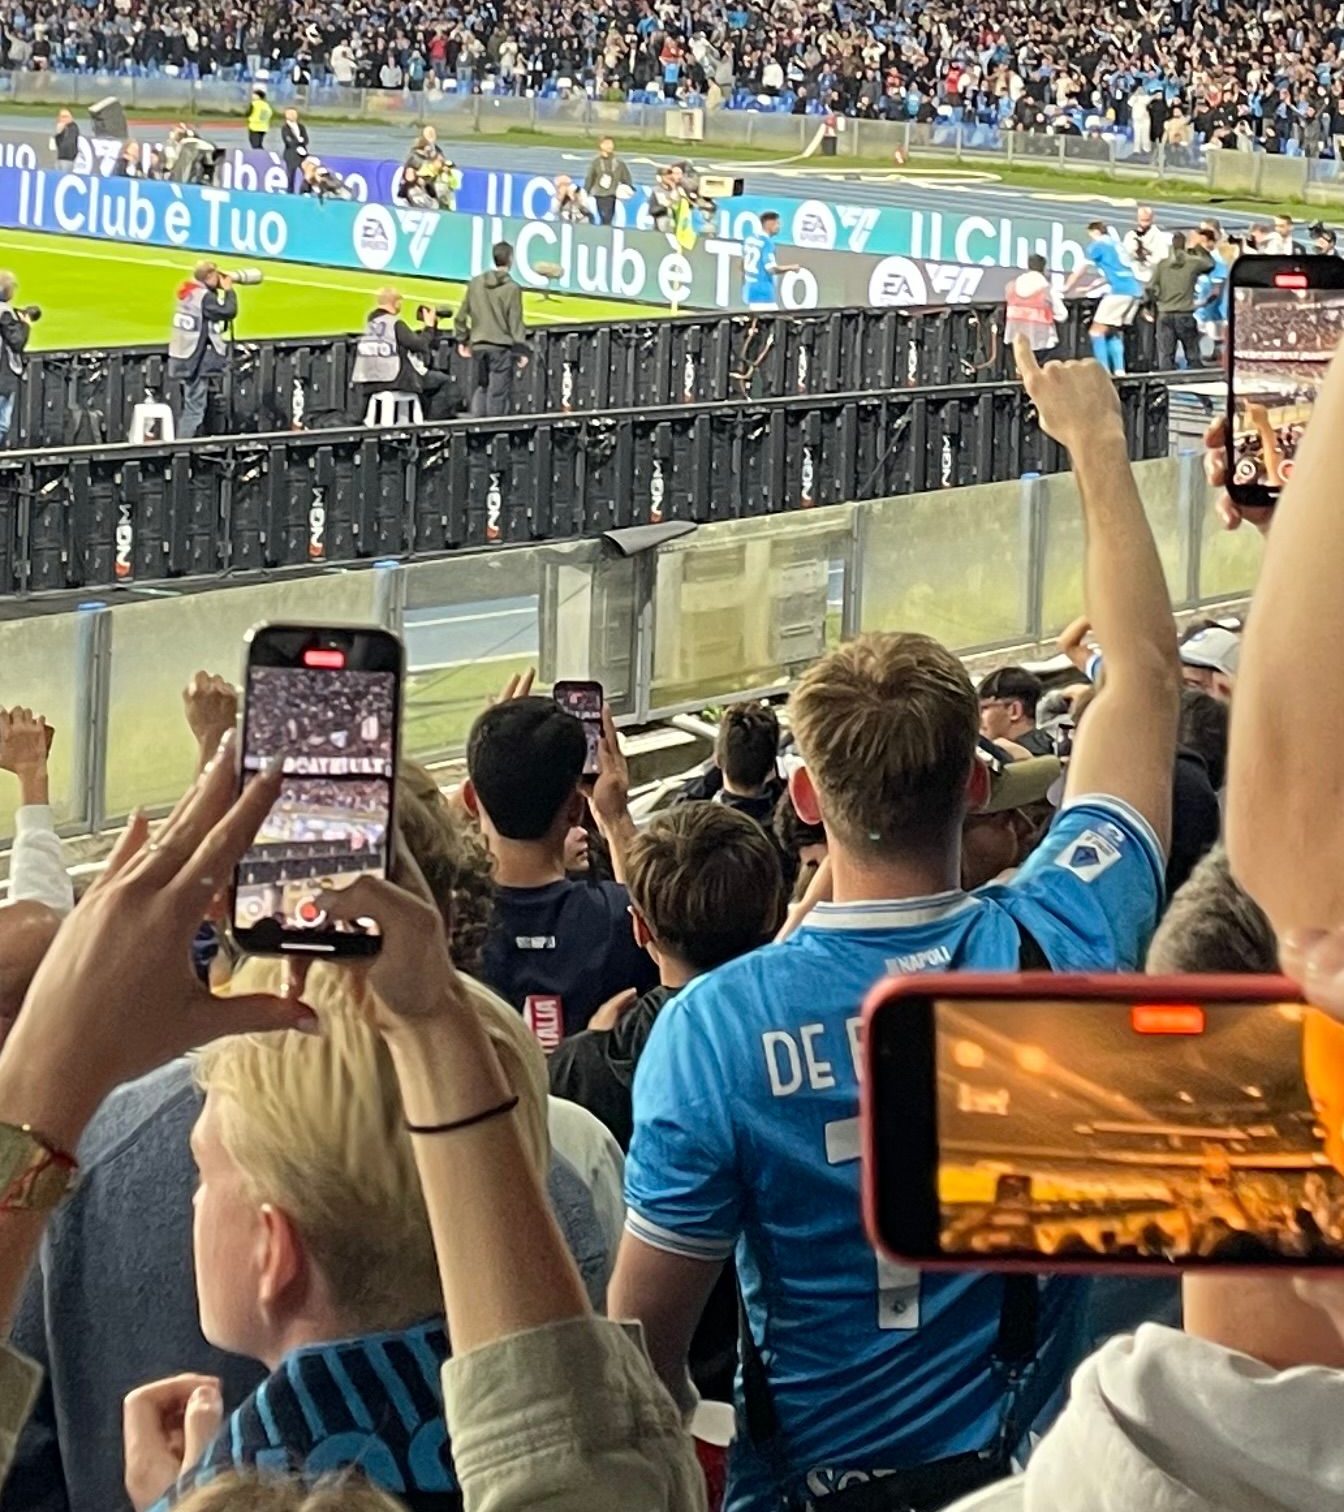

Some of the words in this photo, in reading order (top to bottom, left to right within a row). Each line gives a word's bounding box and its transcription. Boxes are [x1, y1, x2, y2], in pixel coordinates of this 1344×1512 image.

[18, 170, 46, 227] Il
[55, 174, 156, 240] Club
[164, 184, 191, 244] è
[200, 188, 288, 255] Tuo
[515, 222, 647, 297] Club
[704, 239, 819, 310] To
[954, 214, 1086, 273] Club
[310, 487, 325, 547] NGM
[486, 473, 501, 529] NGM
[116, 503, 133, 565] NGM
[897, 946, 950, 974] NAPOLI
[762, 1023, 835, 1096] DE
